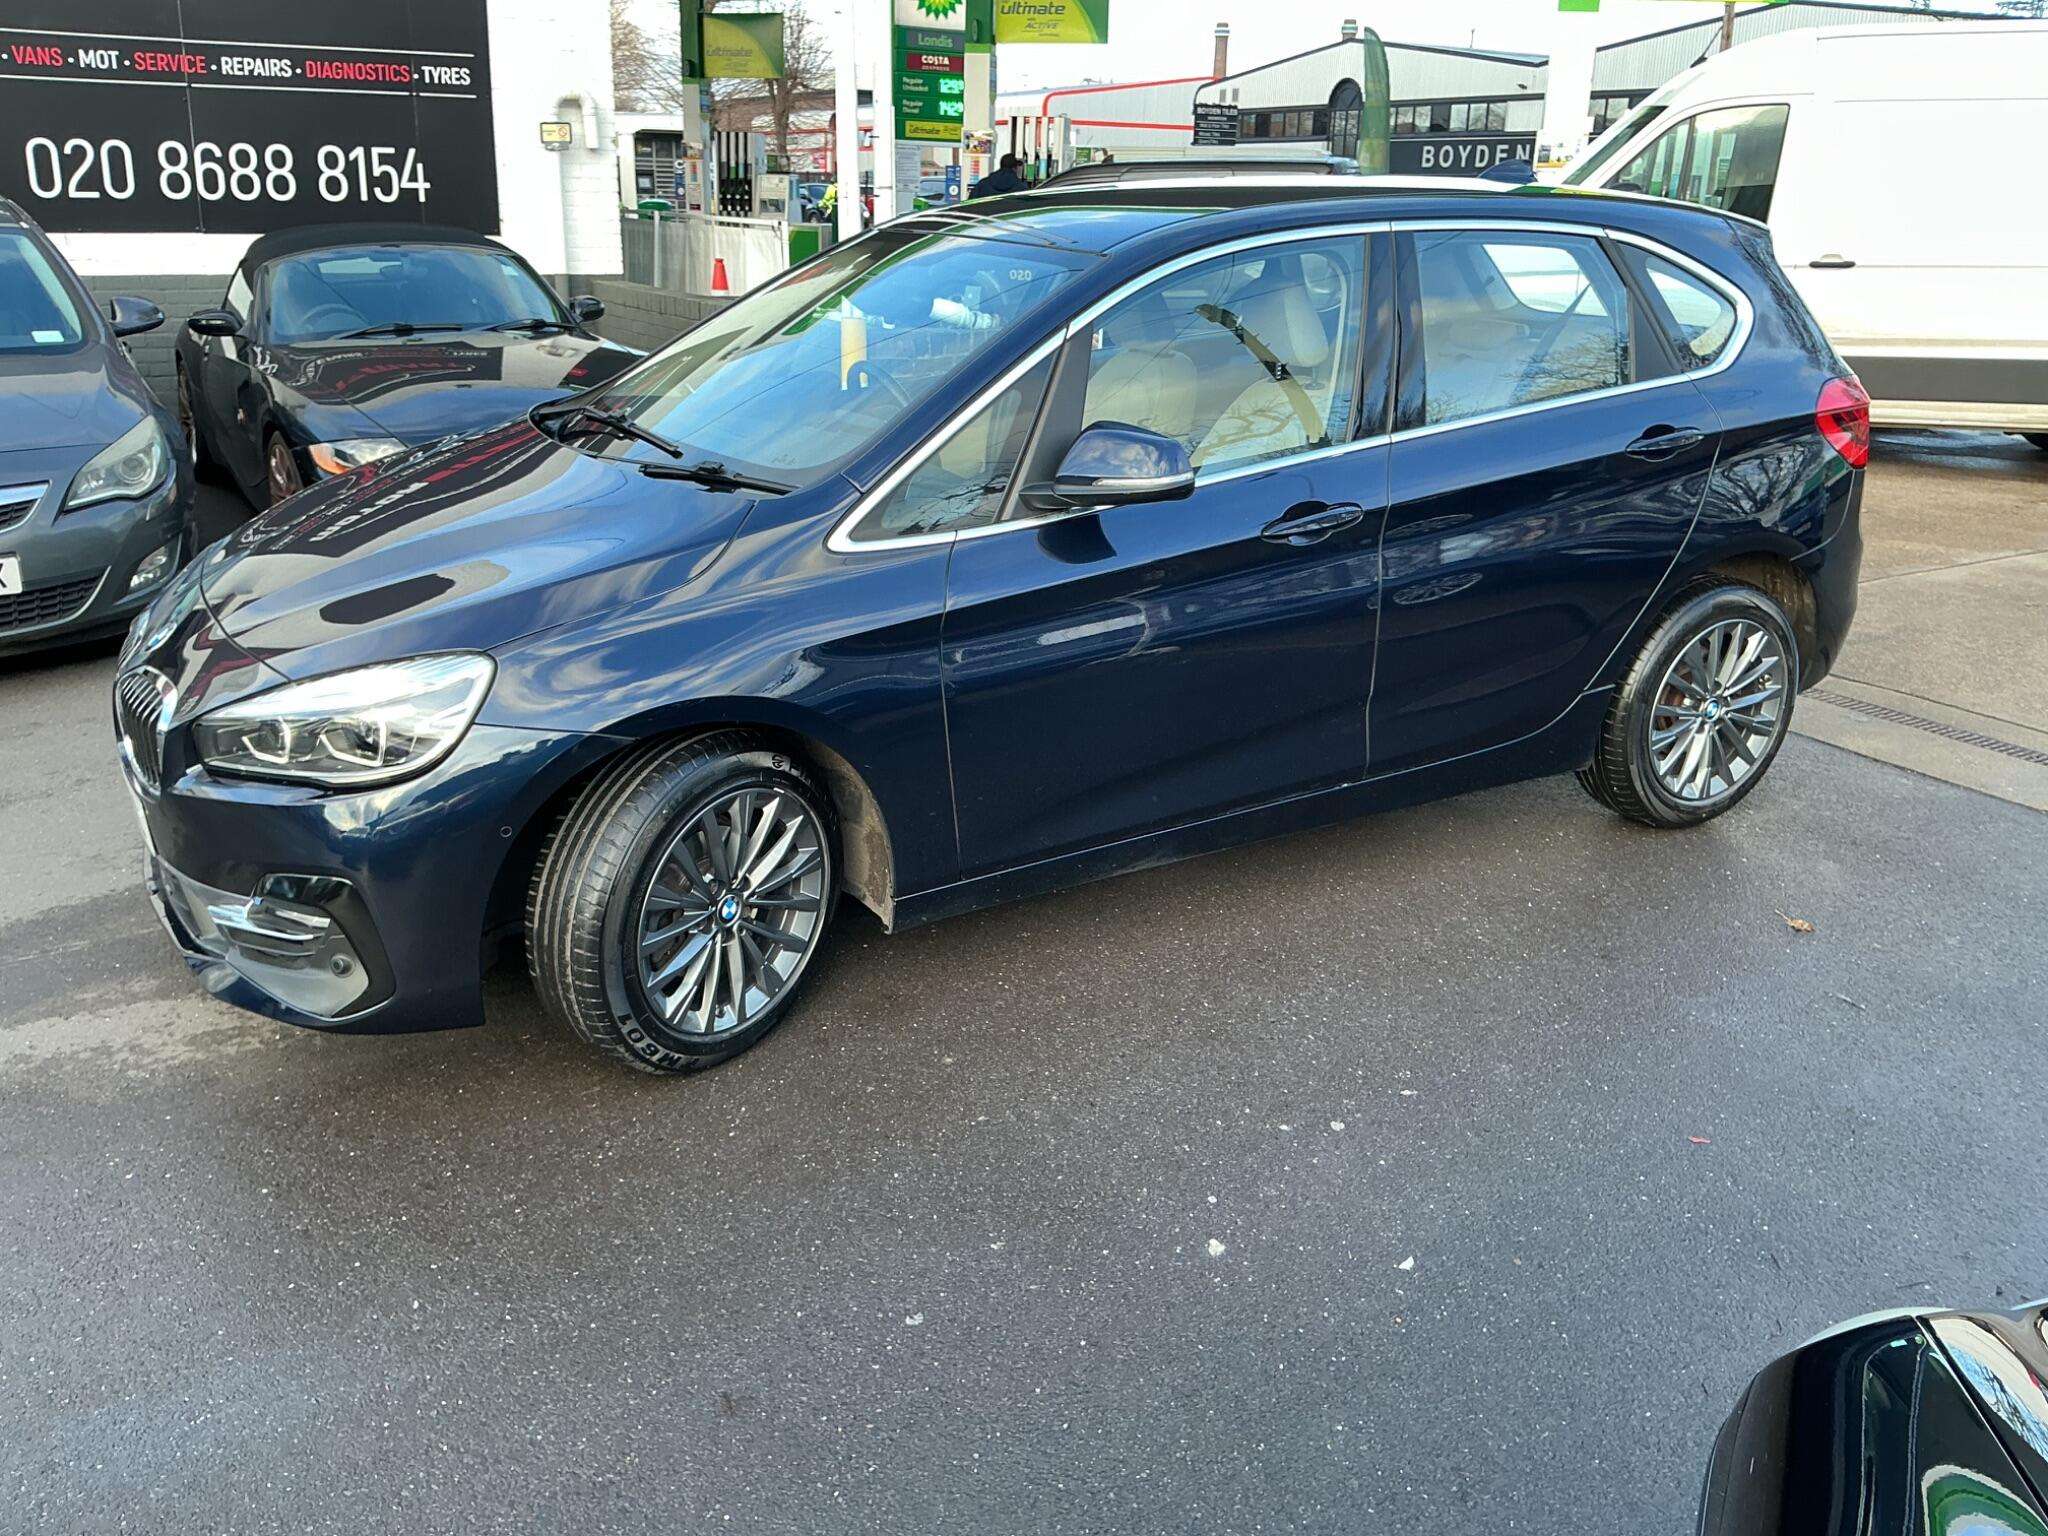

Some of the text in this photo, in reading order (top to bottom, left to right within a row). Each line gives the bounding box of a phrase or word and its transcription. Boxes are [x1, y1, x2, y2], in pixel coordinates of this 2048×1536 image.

[918, 33, 953, 48] Londis
[11, 44, 471, 86] VANS MOT SERVICE REPAIRS DIAGNOSTICS TYRES
[921, 54, 950, 65] COSTA
[1421, 144, 1531, 168] BOYDEN
[25, 136, 432, 203] 020 8688 8154
[1009, 269, 1032, 281] 020
